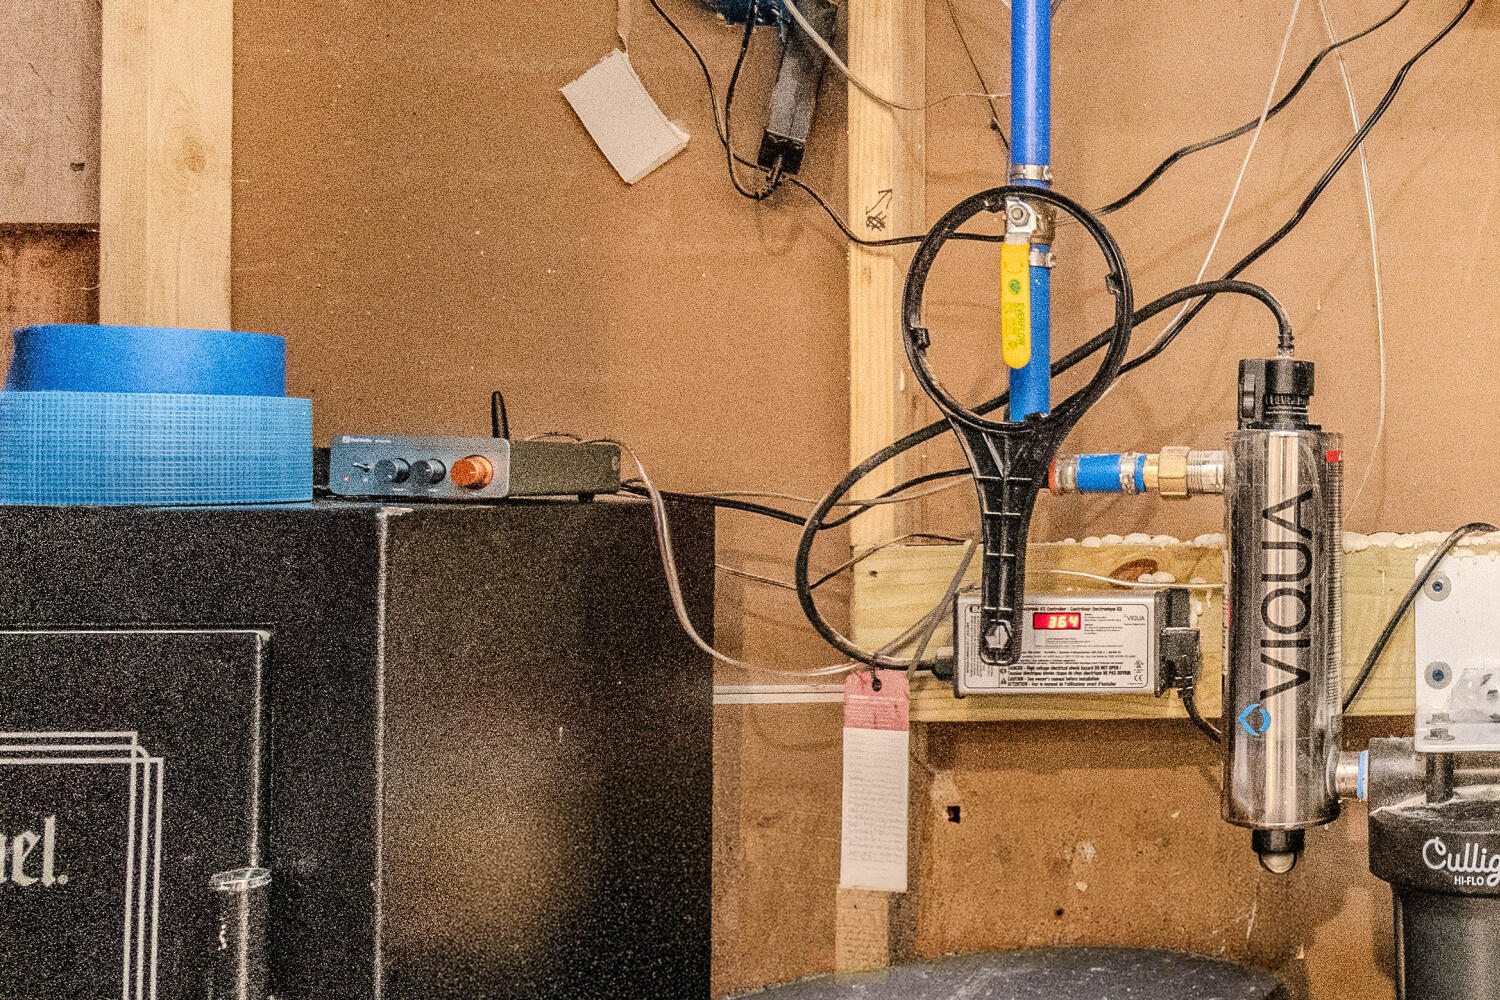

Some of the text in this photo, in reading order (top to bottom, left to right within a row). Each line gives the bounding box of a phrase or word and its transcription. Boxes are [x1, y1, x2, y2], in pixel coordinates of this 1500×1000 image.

[1259, 488, 1315, 701] VIQUA
[1048, 615, 1080, 629] 364
[1454, 875, 1485, 886] HI-FLO
